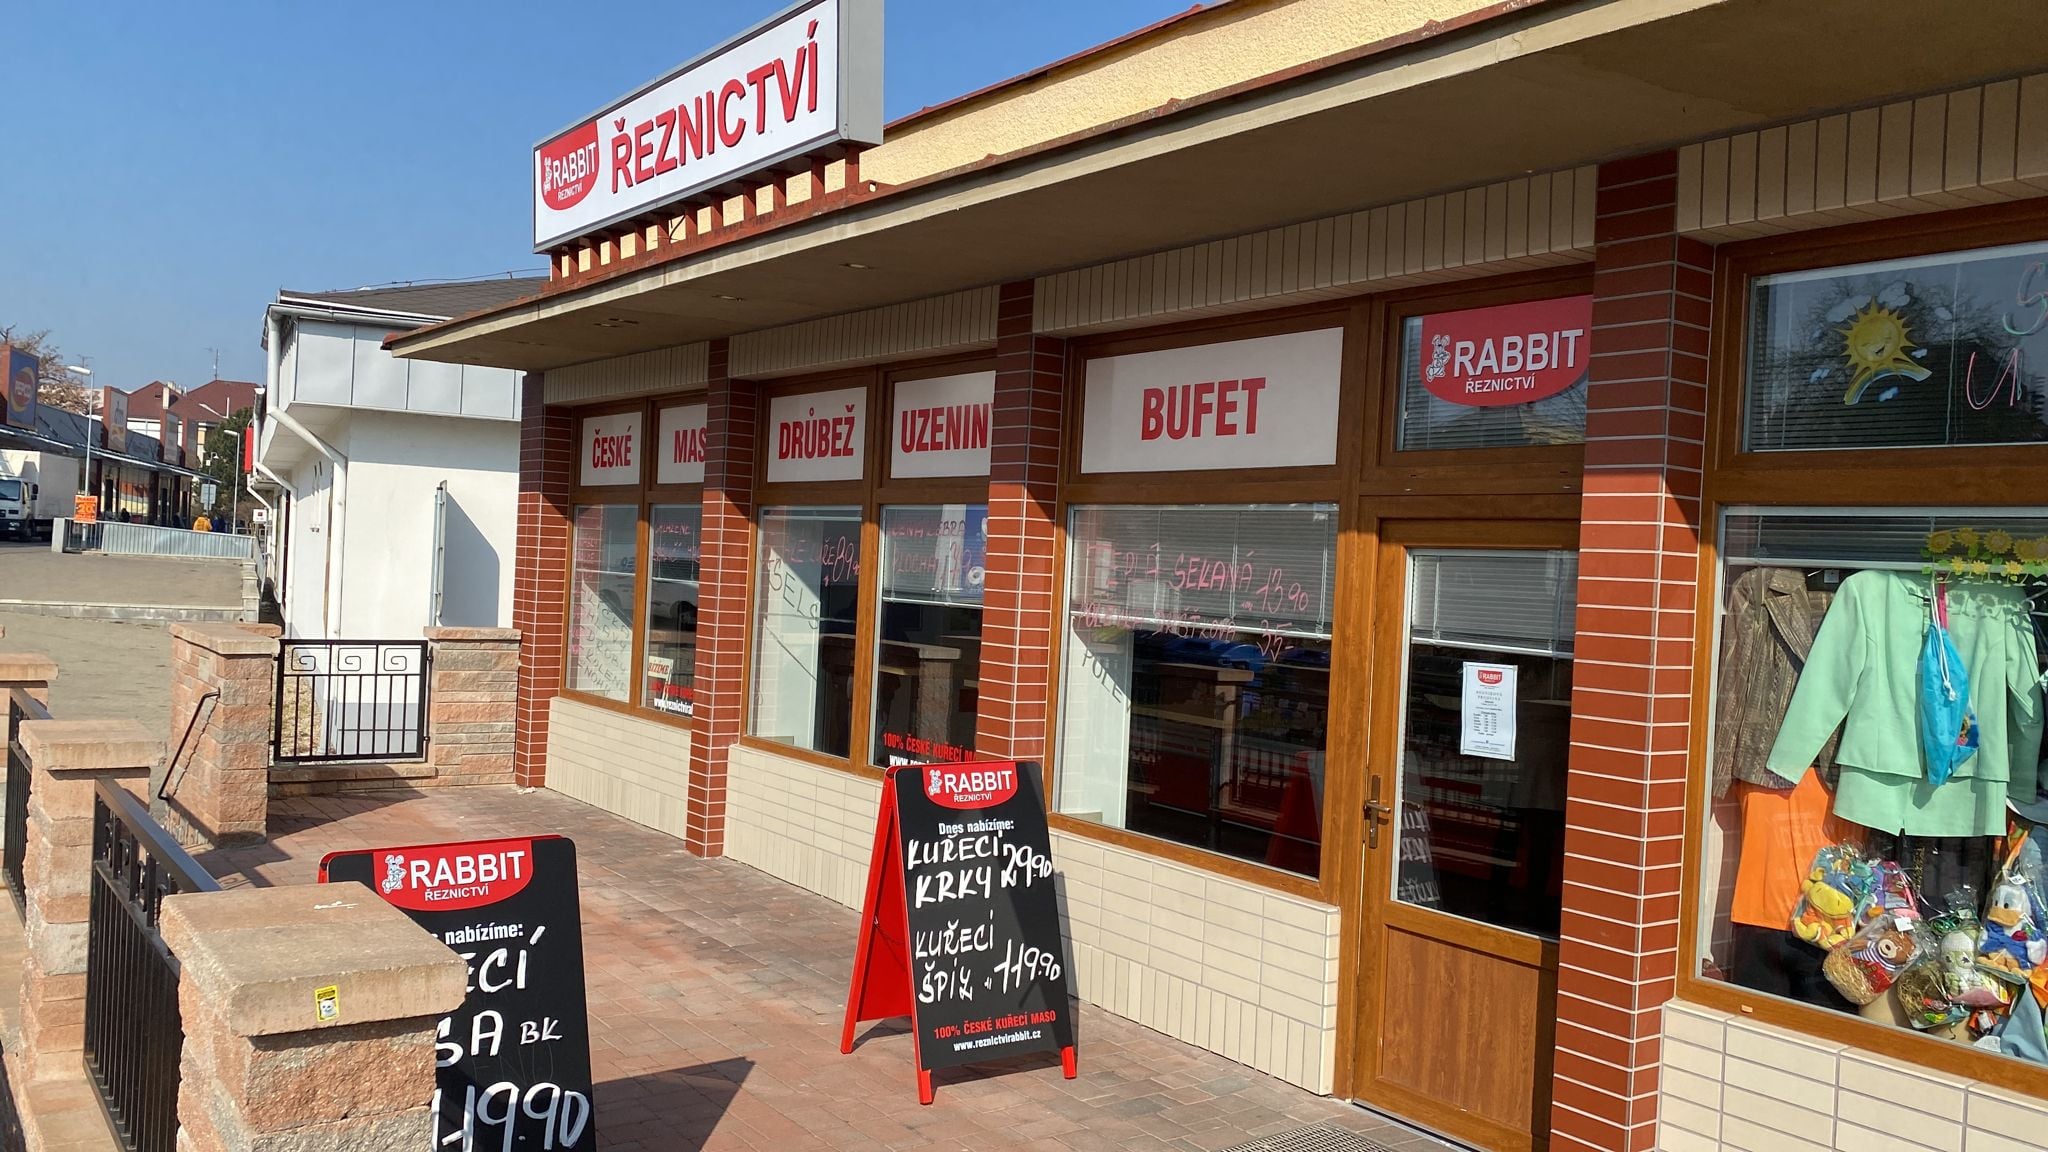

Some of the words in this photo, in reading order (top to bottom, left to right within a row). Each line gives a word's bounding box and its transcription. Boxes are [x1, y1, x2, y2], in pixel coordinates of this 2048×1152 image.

[611, 19, 819, 194] ŘEZNICTVÍ
[552, 141, 597, 190] RABBIT
[1453, 329, 1584, 377] RABBIT
[1465, 373, 1535, 394] ŘEZNICTVÍ
[901, 402, 993, 454] UZENIN
[1140, 376, 1266, 441] BUFET
[592, 425, 632, 469] ČESKÉ
[778, 404, 856, 460] DRŮBEŽ
[883, 732, 904, 750] 100%
[906, 732, 931, 755] ČESKÉ
[944, 770, 1013, 793] RABBIT
[953, 791, 993, 802] ŘEZNICTVÍ
[938, 822, 964, 835] Dnes
[967, 818, 1015, 832] nabízíme:
[409, 850, 526, 889] RABBIT
[907, 830, 1003, 871] KUŘECÍ
[424, 885, 490, 902] ŘEZNICTVÍ
[915, 866, 992, 908] KRKY
[445, 922, 524, 945] nabízíme:
[915, 908, 994, 960] KUŘECÍ
[519, 1017, 563, 1045] BK
[934, 1024, 961, 1040] 100%
[963, 1016, 993, 1035] ČESKÉ
[995, 1011, 1028, 1030] KUŘECÍ
[1031, 1010, 1057, 1025] MASO
[953, 1029, 1042, 1052] www.reznictvirabbit.cz
